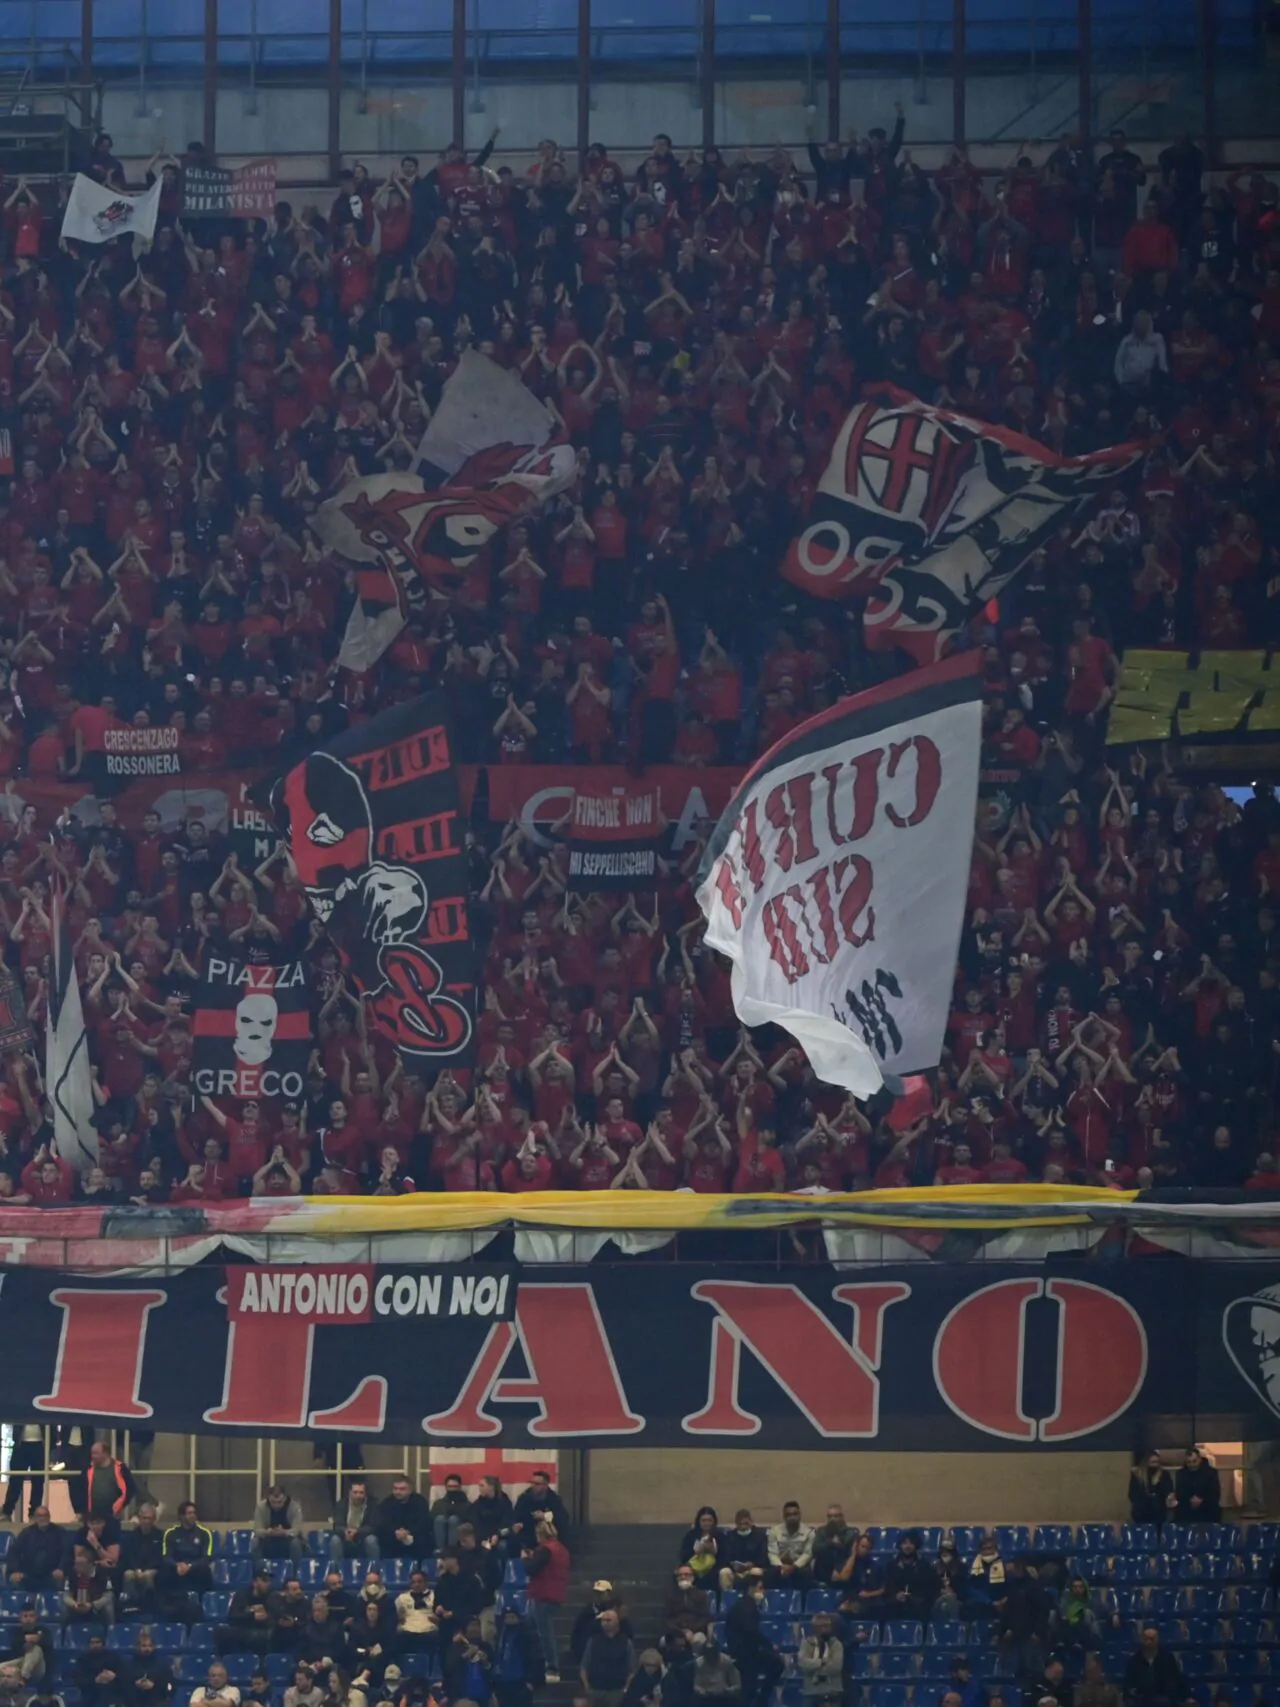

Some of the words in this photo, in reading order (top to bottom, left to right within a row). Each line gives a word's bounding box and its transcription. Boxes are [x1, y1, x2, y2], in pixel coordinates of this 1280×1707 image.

[183, 193, 275, 211] MILANISTA
[104, 727, 179, 750] CRESCENZAGO
[106, 753, 180, 775] ROSSONERA
[626, 794, 651, 827] NON
[207, 957, 306, 989] PIAZZA
[194, 1067, 305, 1099] GRECO
[239, 1272, 368, 1315] ANTONIO
[373, 1274, 443, 1316] CON
[448, 1273, 511, 1317] NOI
